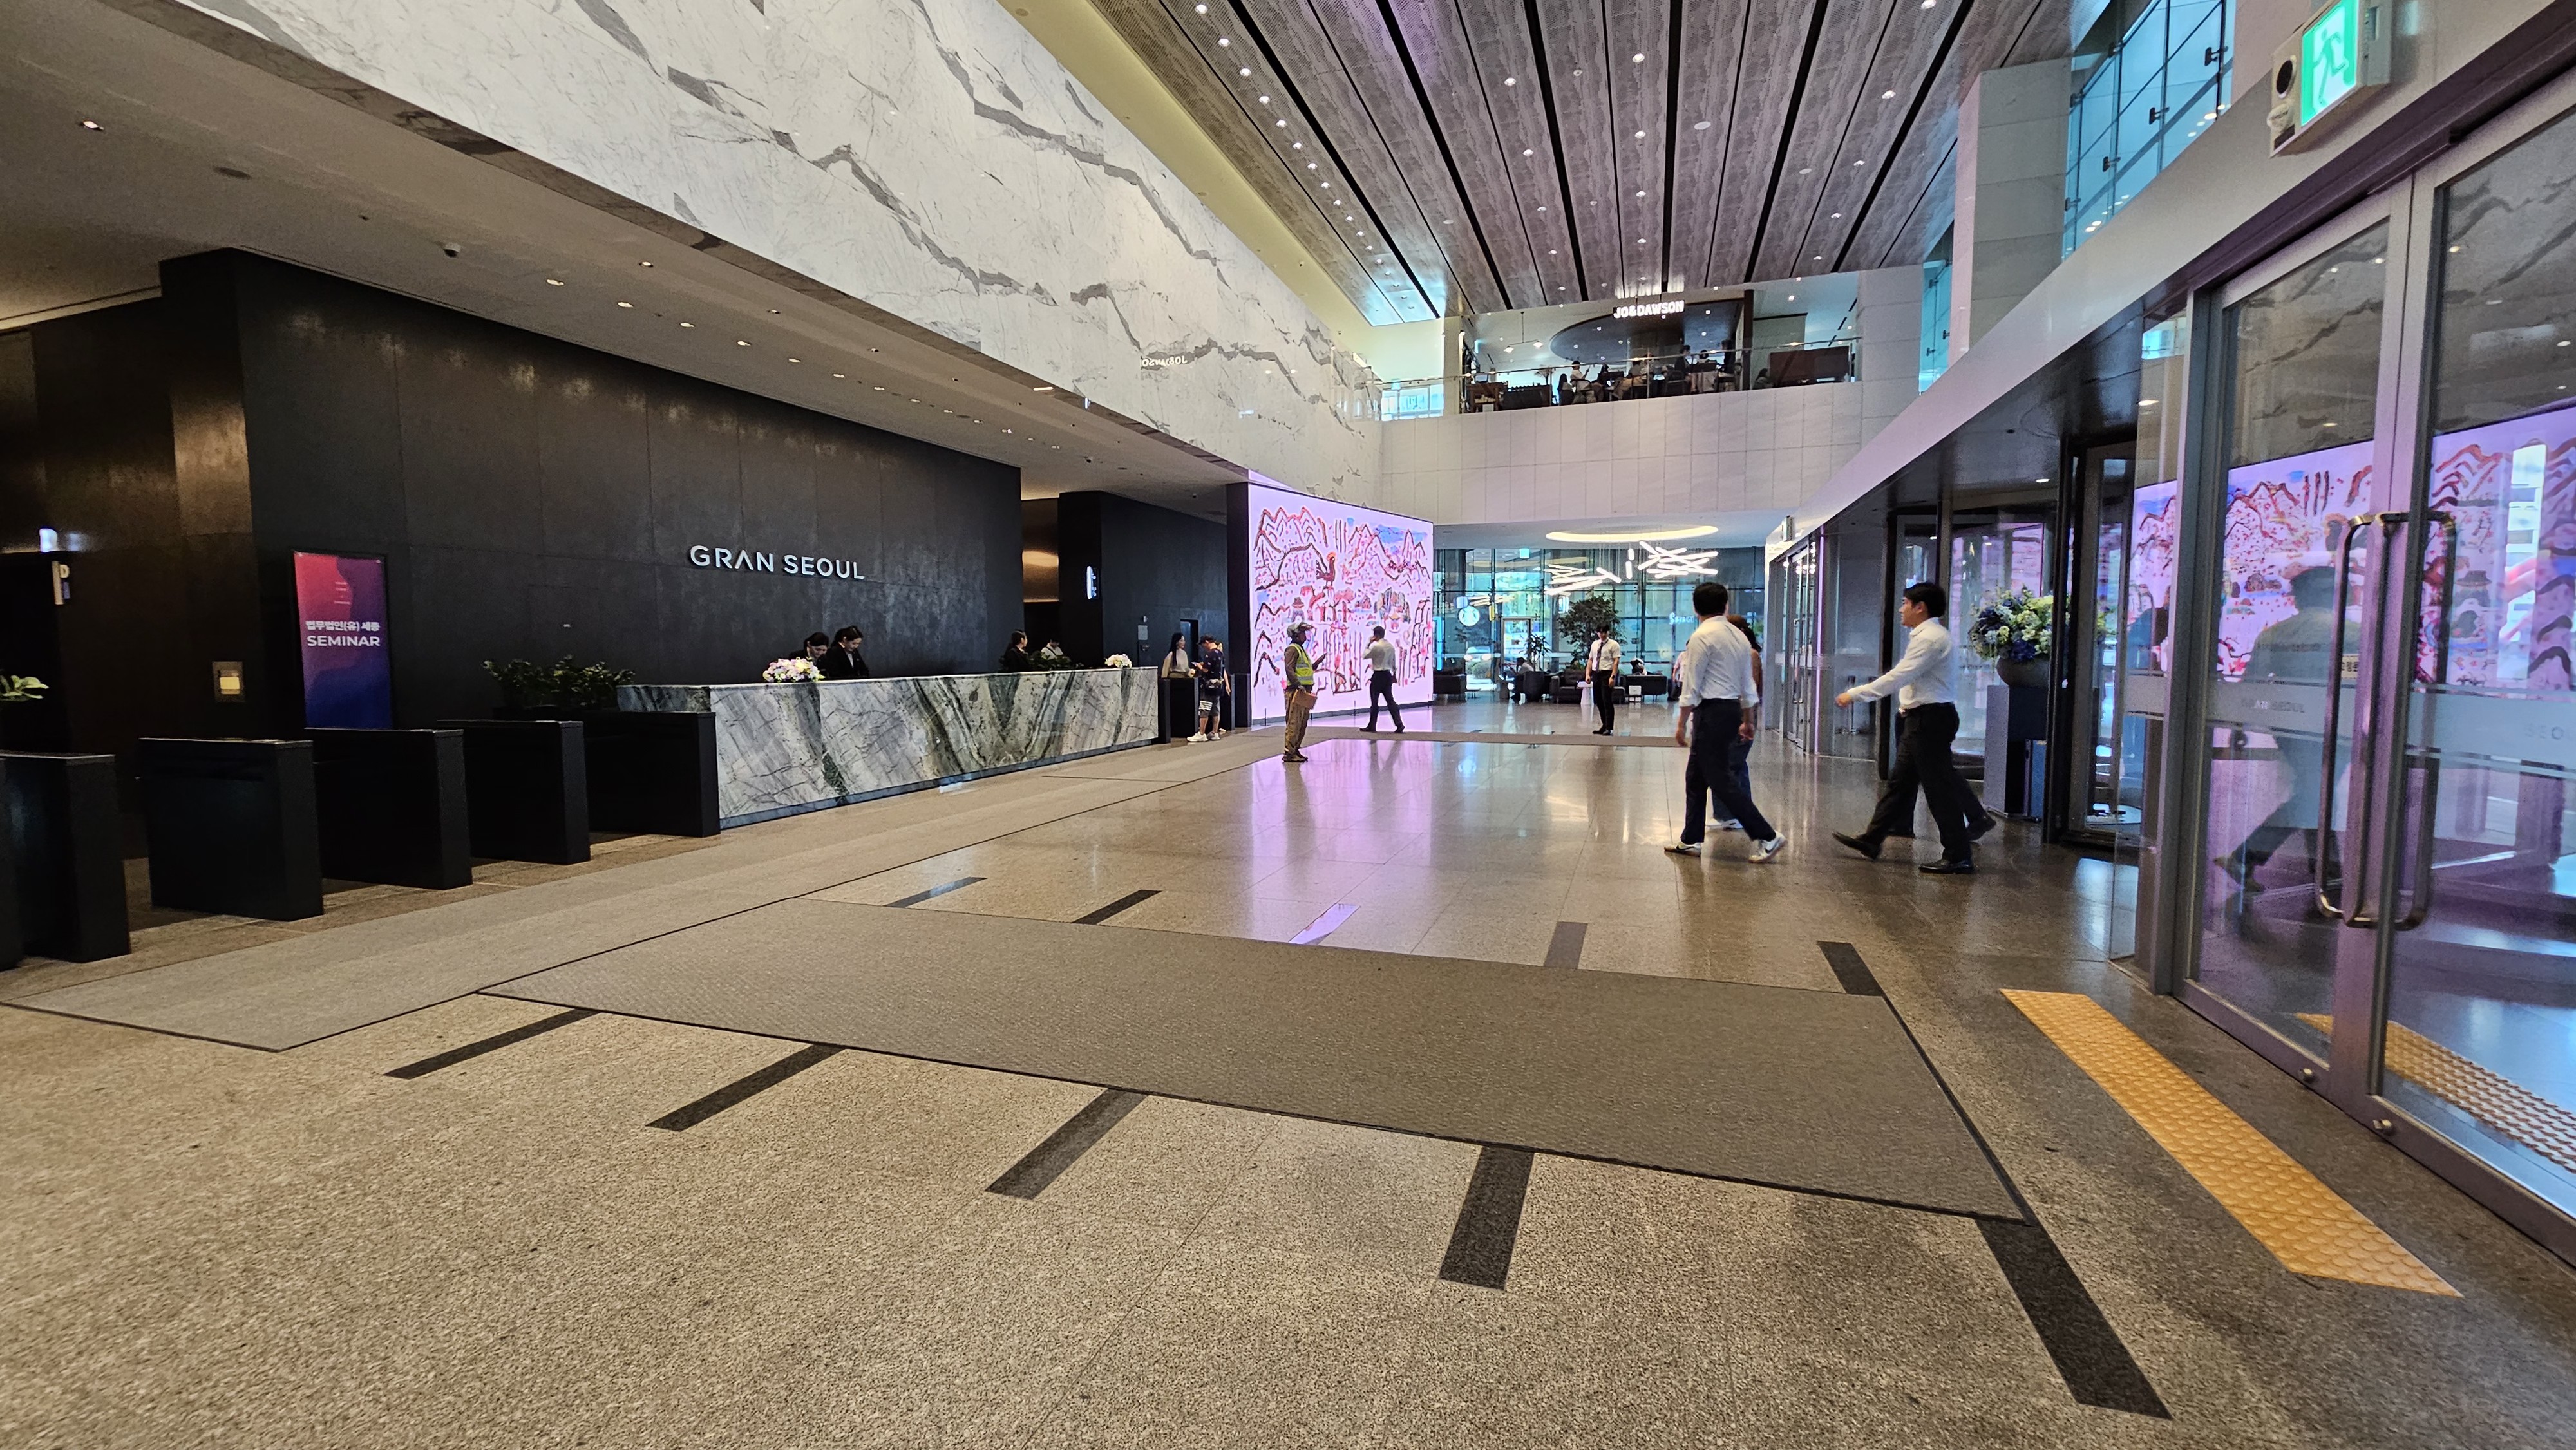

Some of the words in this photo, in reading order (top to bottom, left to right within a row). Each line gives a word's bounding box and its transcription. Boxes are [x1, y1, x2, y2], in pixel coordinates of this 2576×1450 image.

[1613, 300, 1685, 319] JO&DAWSON
[690, 545, 774, 572] GRAN
[783, 554, 865, 580] SEOUL
[307, 635, 381, 646] SEMINAR
